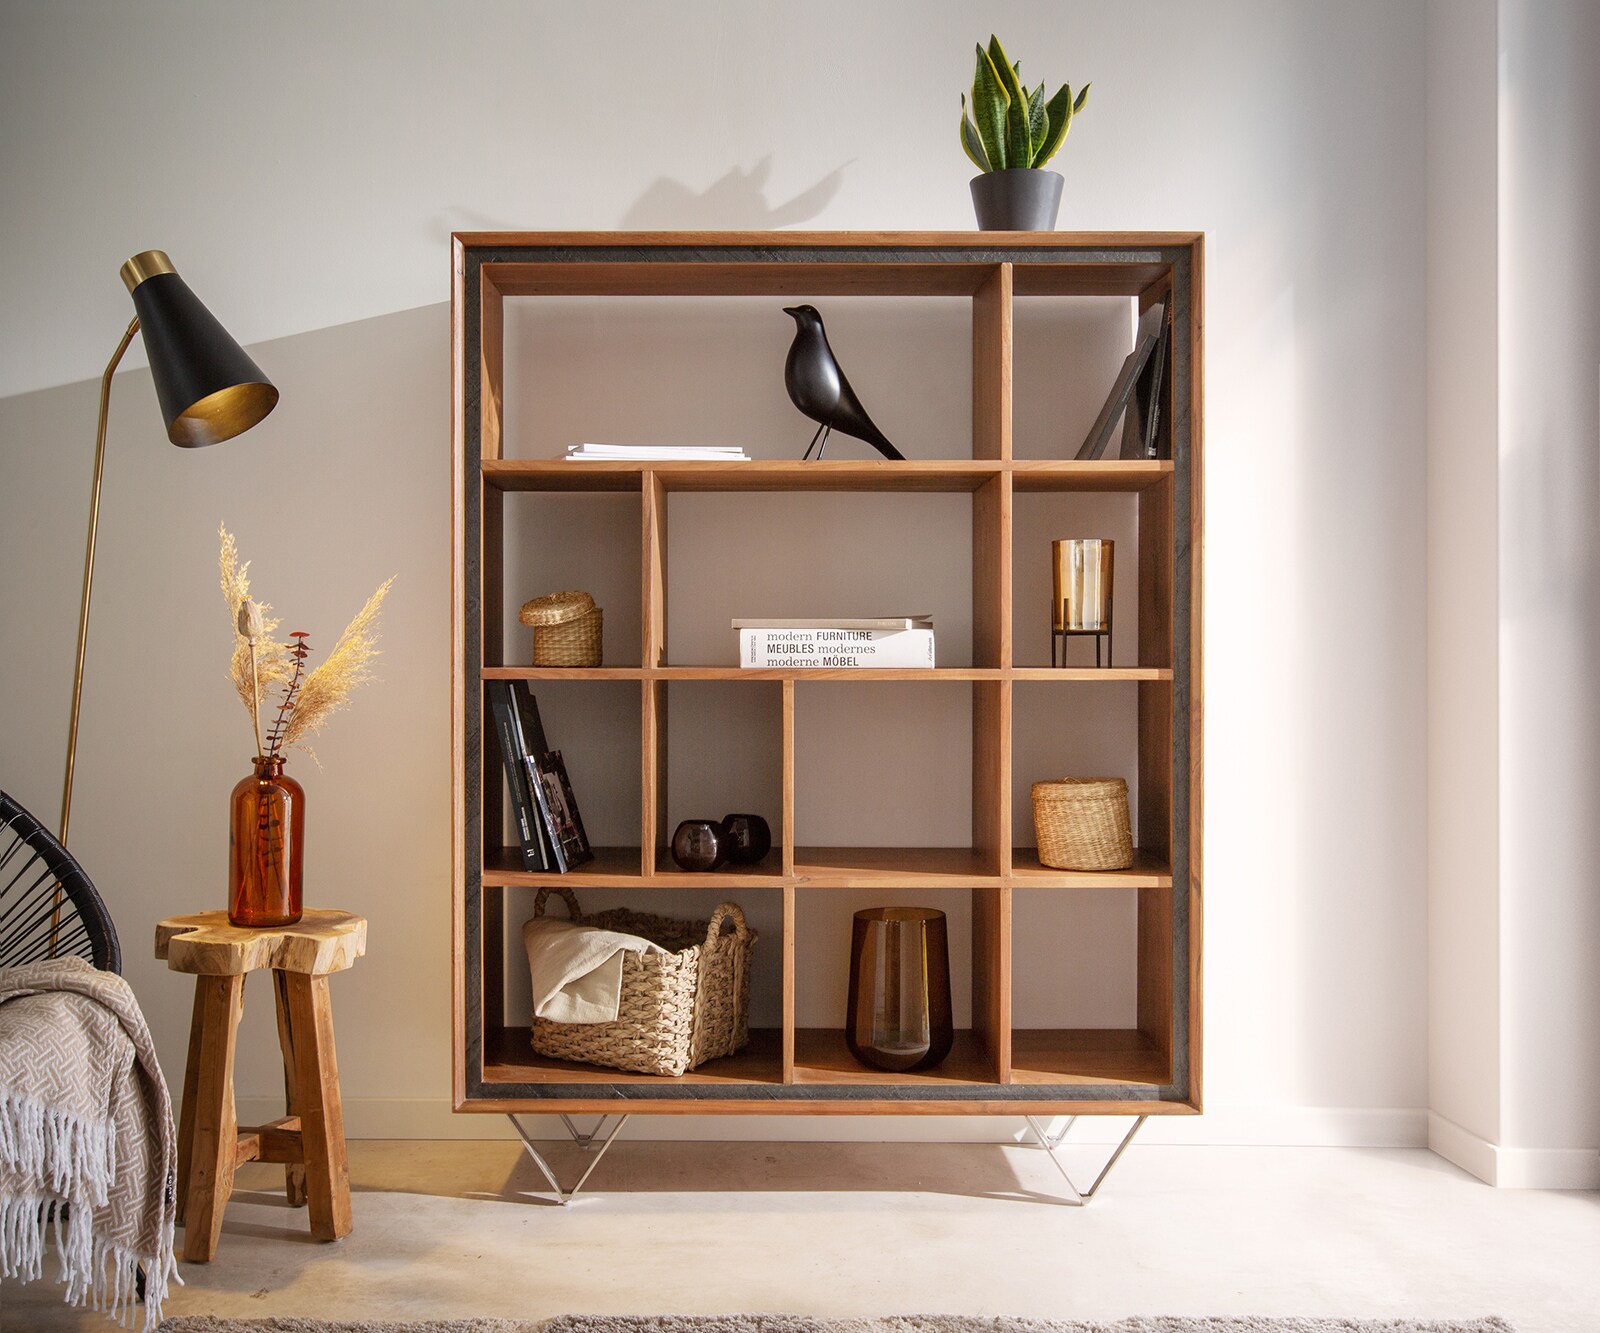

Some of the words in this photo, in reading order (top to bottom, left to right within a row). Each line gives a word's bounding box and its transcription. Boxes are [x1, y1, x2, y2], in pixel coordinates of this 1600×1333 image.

[767, 632, 812, 641] modern
[816, 631, 872, 641] FURNITURE
[767, 644, 814, 653] MEUBLES
[818, 643, 876, 654] modernes
[767, 656, 819, 667] moderne
[822, 654, 859, 667] MÖBEL
